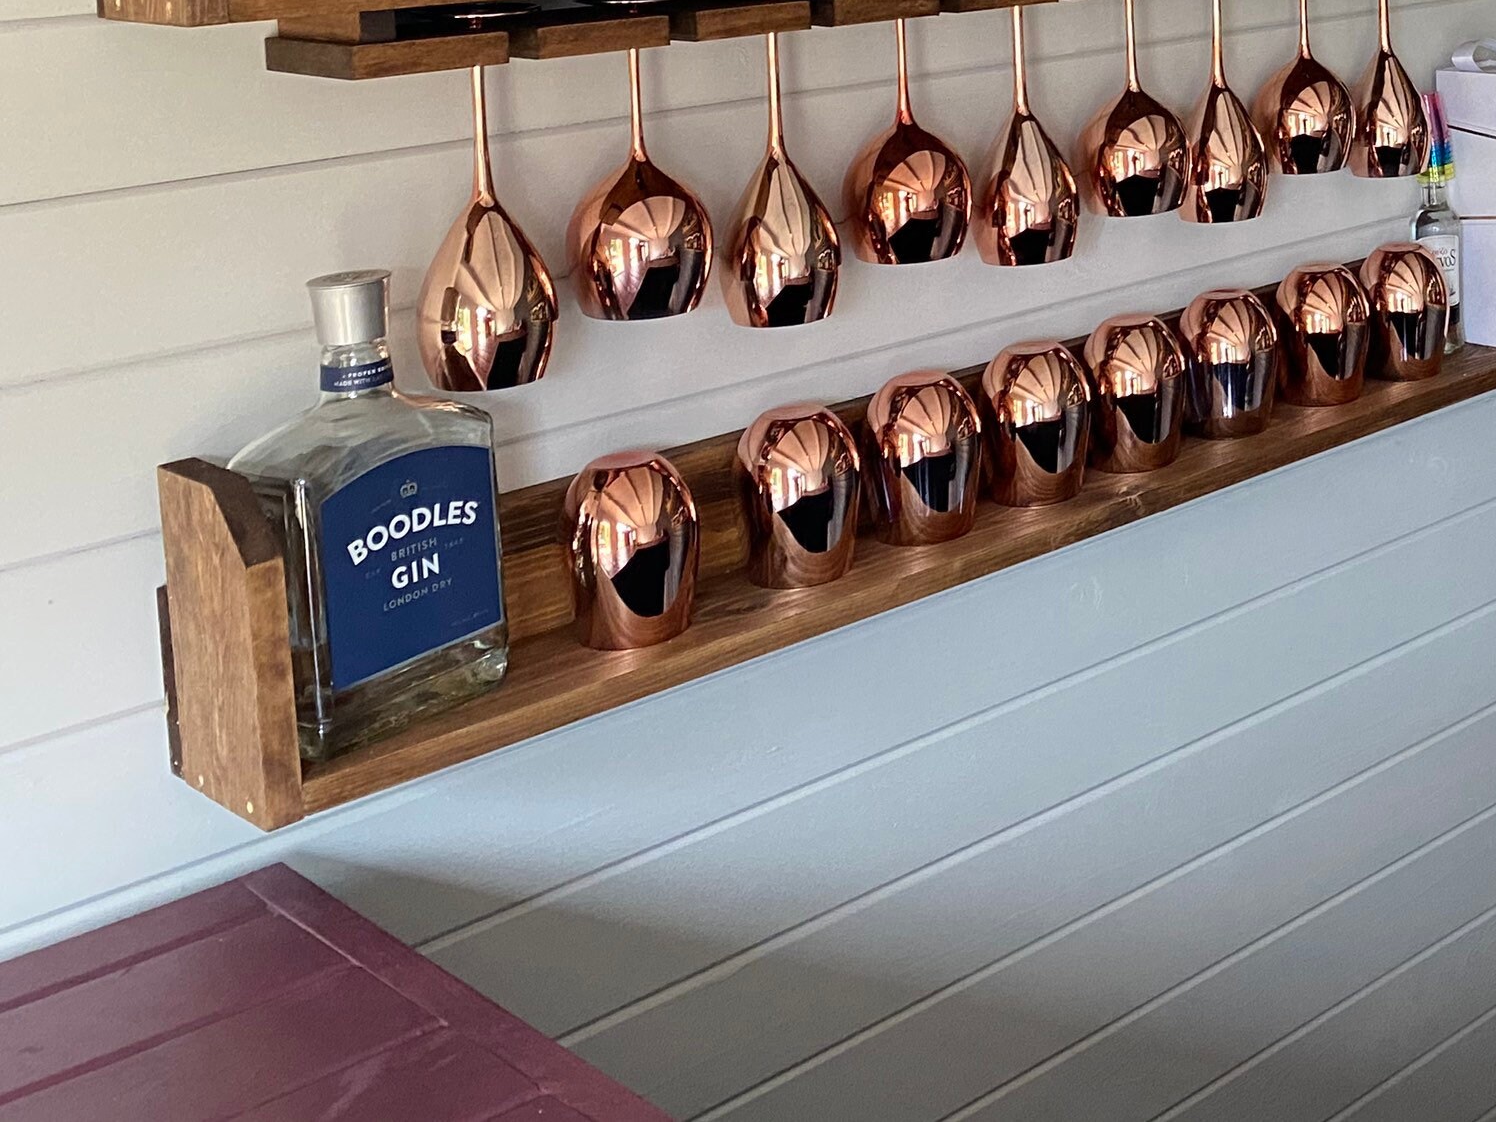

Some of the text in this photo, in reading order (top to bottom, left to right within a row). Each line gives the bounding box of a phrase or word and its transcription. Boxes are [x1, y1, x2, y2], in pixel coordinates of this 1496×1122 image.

[347, 501, 479, 566] BOODLES
[391, 537, 438, 562] BRITISH
[391, 552, 440, 590] GIN
[383, 577, 452, 612] LONDON DRY
